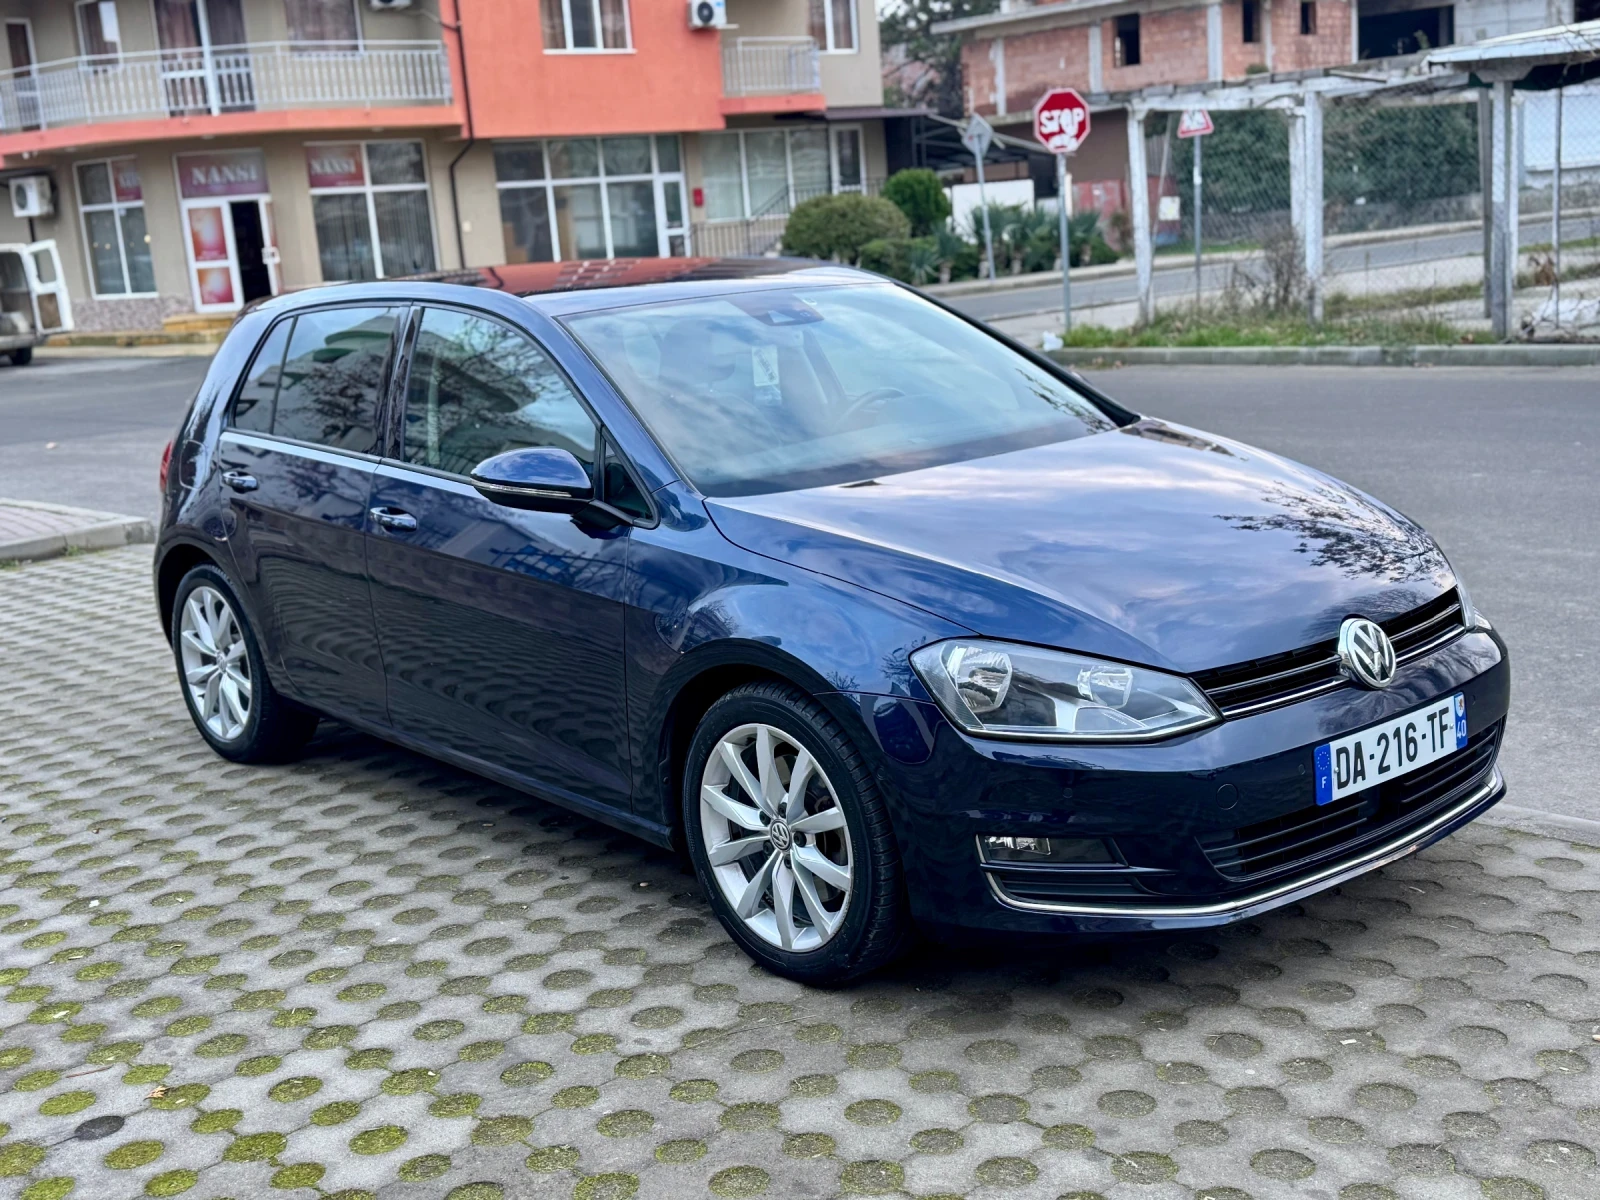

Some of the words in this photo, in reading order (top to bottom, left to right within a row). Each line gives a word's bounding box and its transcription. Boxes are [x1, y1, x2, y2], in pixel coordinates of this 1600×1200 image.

[1040, 107, 1085, 134] STOP
[191, 164, 258, 186] NANSI
[1456, 719, 1467, 739] 40
[1336, 706, 1450, 790] DA-216-TF
[1321, 776, 1327, 789] F
